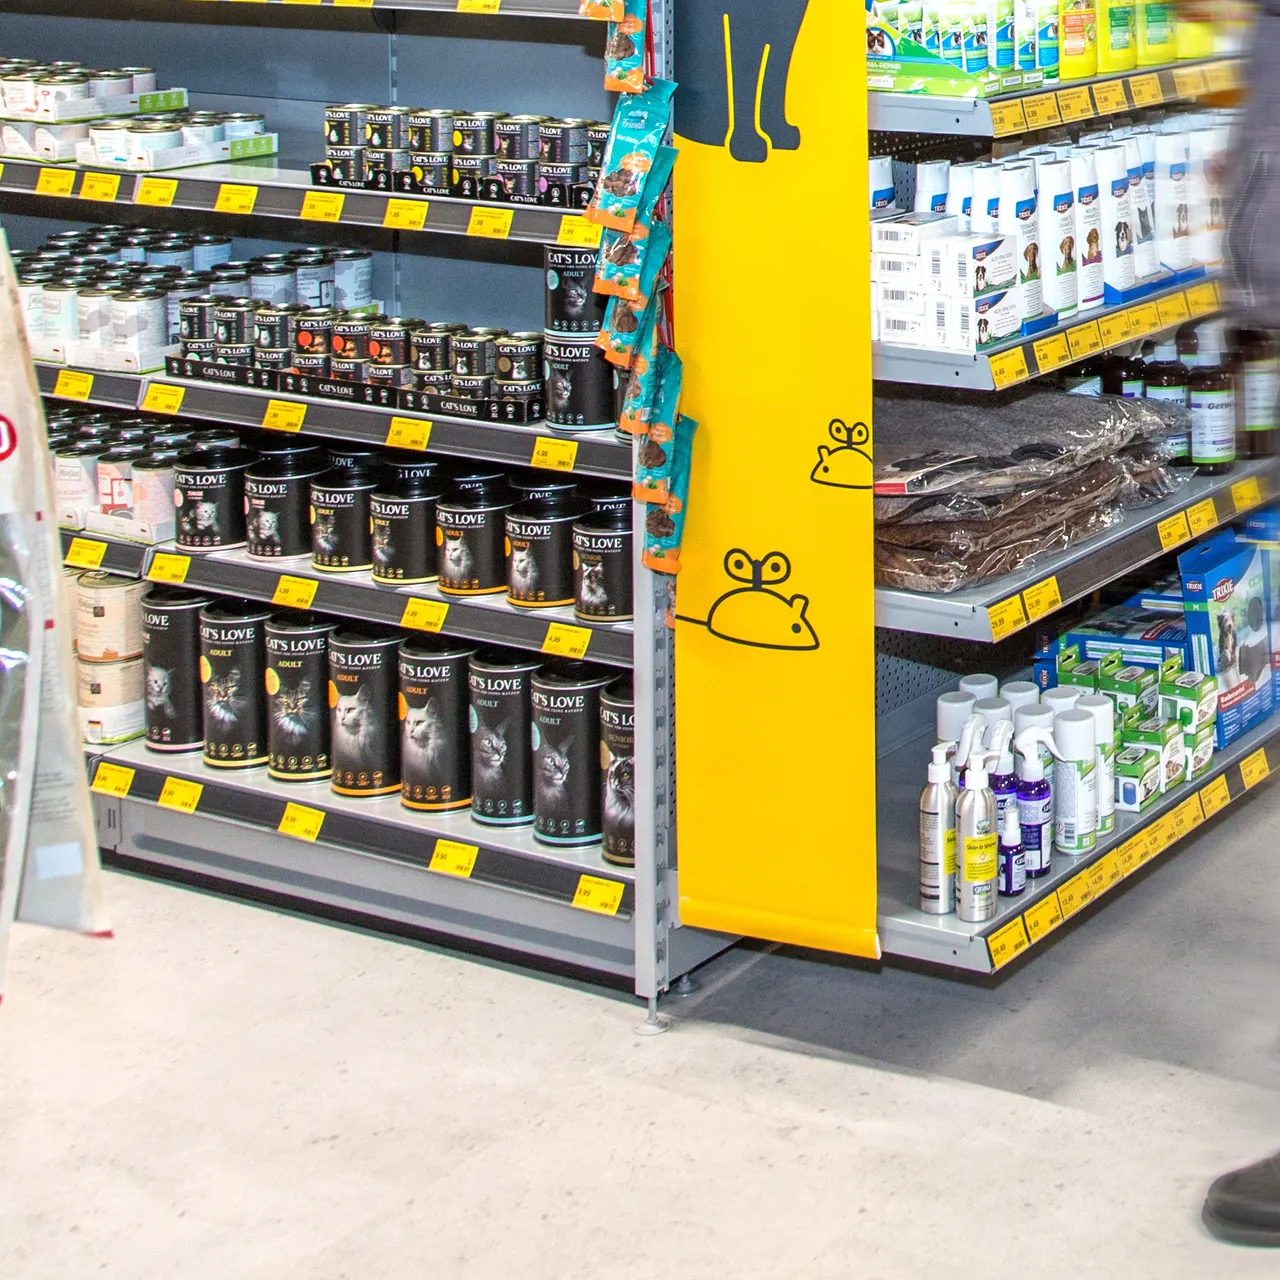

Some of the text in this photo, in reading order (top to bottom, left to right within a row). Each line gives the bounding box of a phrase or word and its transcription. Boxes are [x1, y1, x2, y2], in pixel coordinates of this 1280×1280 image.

[464, 158, 481, 166] LOVE
[1080, 195, 1093, 204] TRIXIE
[548, 252, 599, 264] CAT'S LOV
[350, 325, 368, 333] LOVE
[561, 347, 590, 358] LOVE
[203, 367, 236, 378] CAT'S LOVE
[319, 383, 354, 395] CAT'S LOVE
[523, 383, 541, 391] LOVE
[441, 400, 477, 413] CAT'S LOVE
[196, 474, 227, 485] LOVE
[258, 484, 287, 494] LOVE
[325, 493, 354, 503] LOVE
[382, 505, 410, 515] LOVE
[455, 514, 485, 525] LOVE
[521, 525, 552, 535] LOVE
[591, 538, 622, 548] LOVE
[1186, 582, 1202, 591] TRIXIE
[1212, 579, 1235, 601] TRIXIE
[145, 614, 169, 626] LOVE
[221, 627, 255, 641] LOVE
[266, 636, 326, 651] CAT'S LOVE
[209, 649, 233, 657] ADULT
[329, 650, 382, 666] AT'S LOVE
[277, 660, 303, 668] ADULT
[416, 666, 451, 678] LOVE
[336, 673, 359, 682] ADULT
[469, 673, 522, 690] AT'S LOVE
[405, 686, 428, 695] ADULT
[476, 698, 499, 708] ADULT
[531, 690, 585, 707] AT'S LOVE
[538, 715, 562, 725] ADULT
[622, 714, 635, 726] LO
